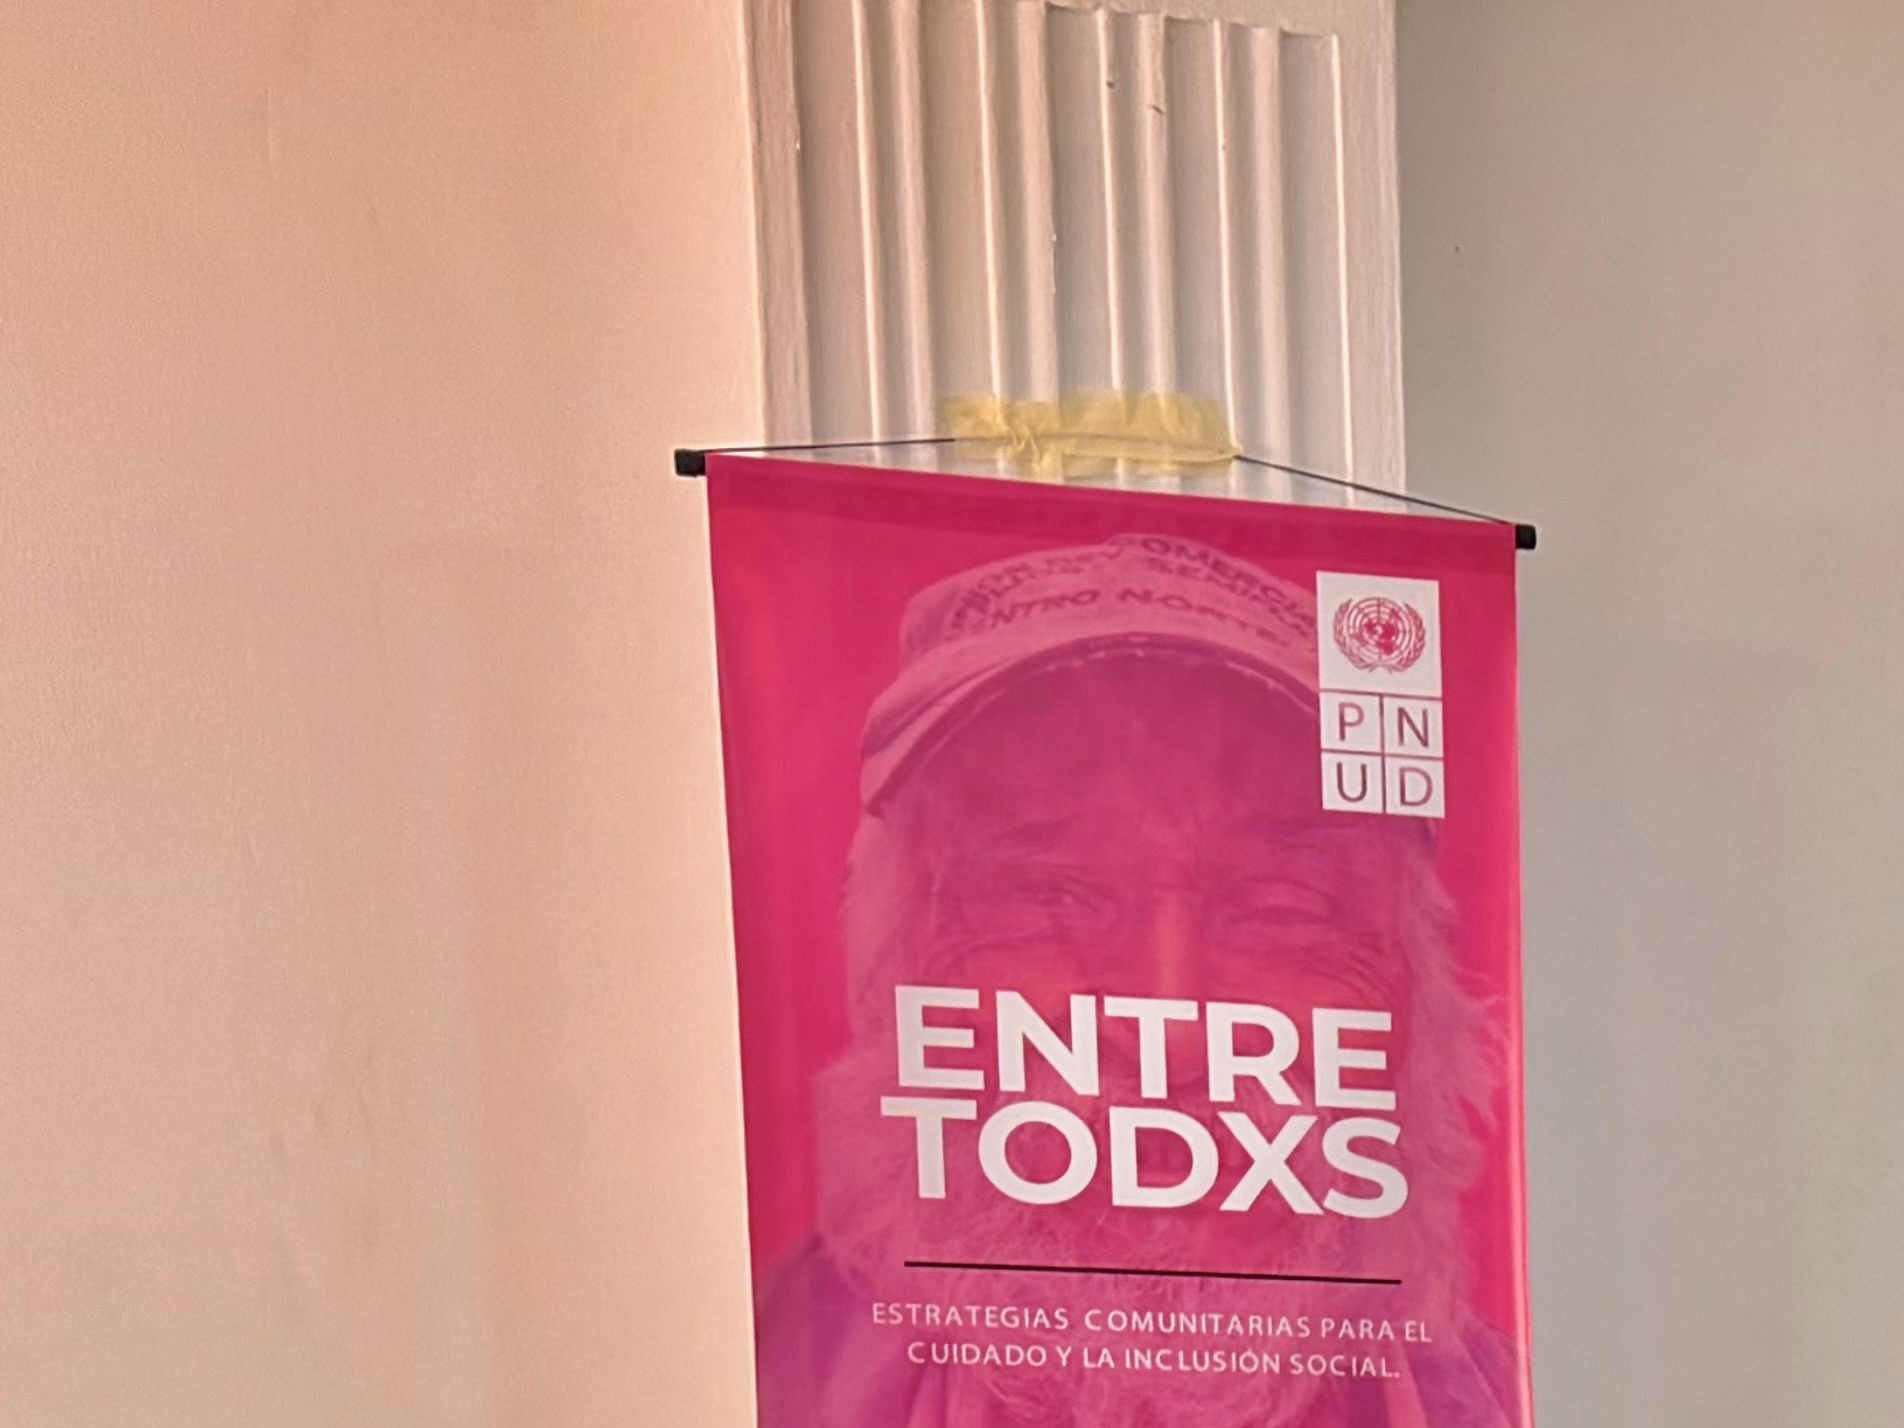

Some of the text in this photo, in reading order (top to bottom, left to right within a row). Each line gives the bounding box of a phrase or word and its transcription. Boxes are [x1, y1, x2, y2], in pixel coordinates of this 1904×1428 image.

[894, 984, 1397, 1111] ENTRE
[880, 1094, 1410, 1220] TODXS
[872, 1301, 1433, 1344] ESTRATEGIAS COMUNITARIAS PARA EL
[906, 1341, 1400, 1379] CUIDADO Y LA INCLUSIÓN SOCIAL.
